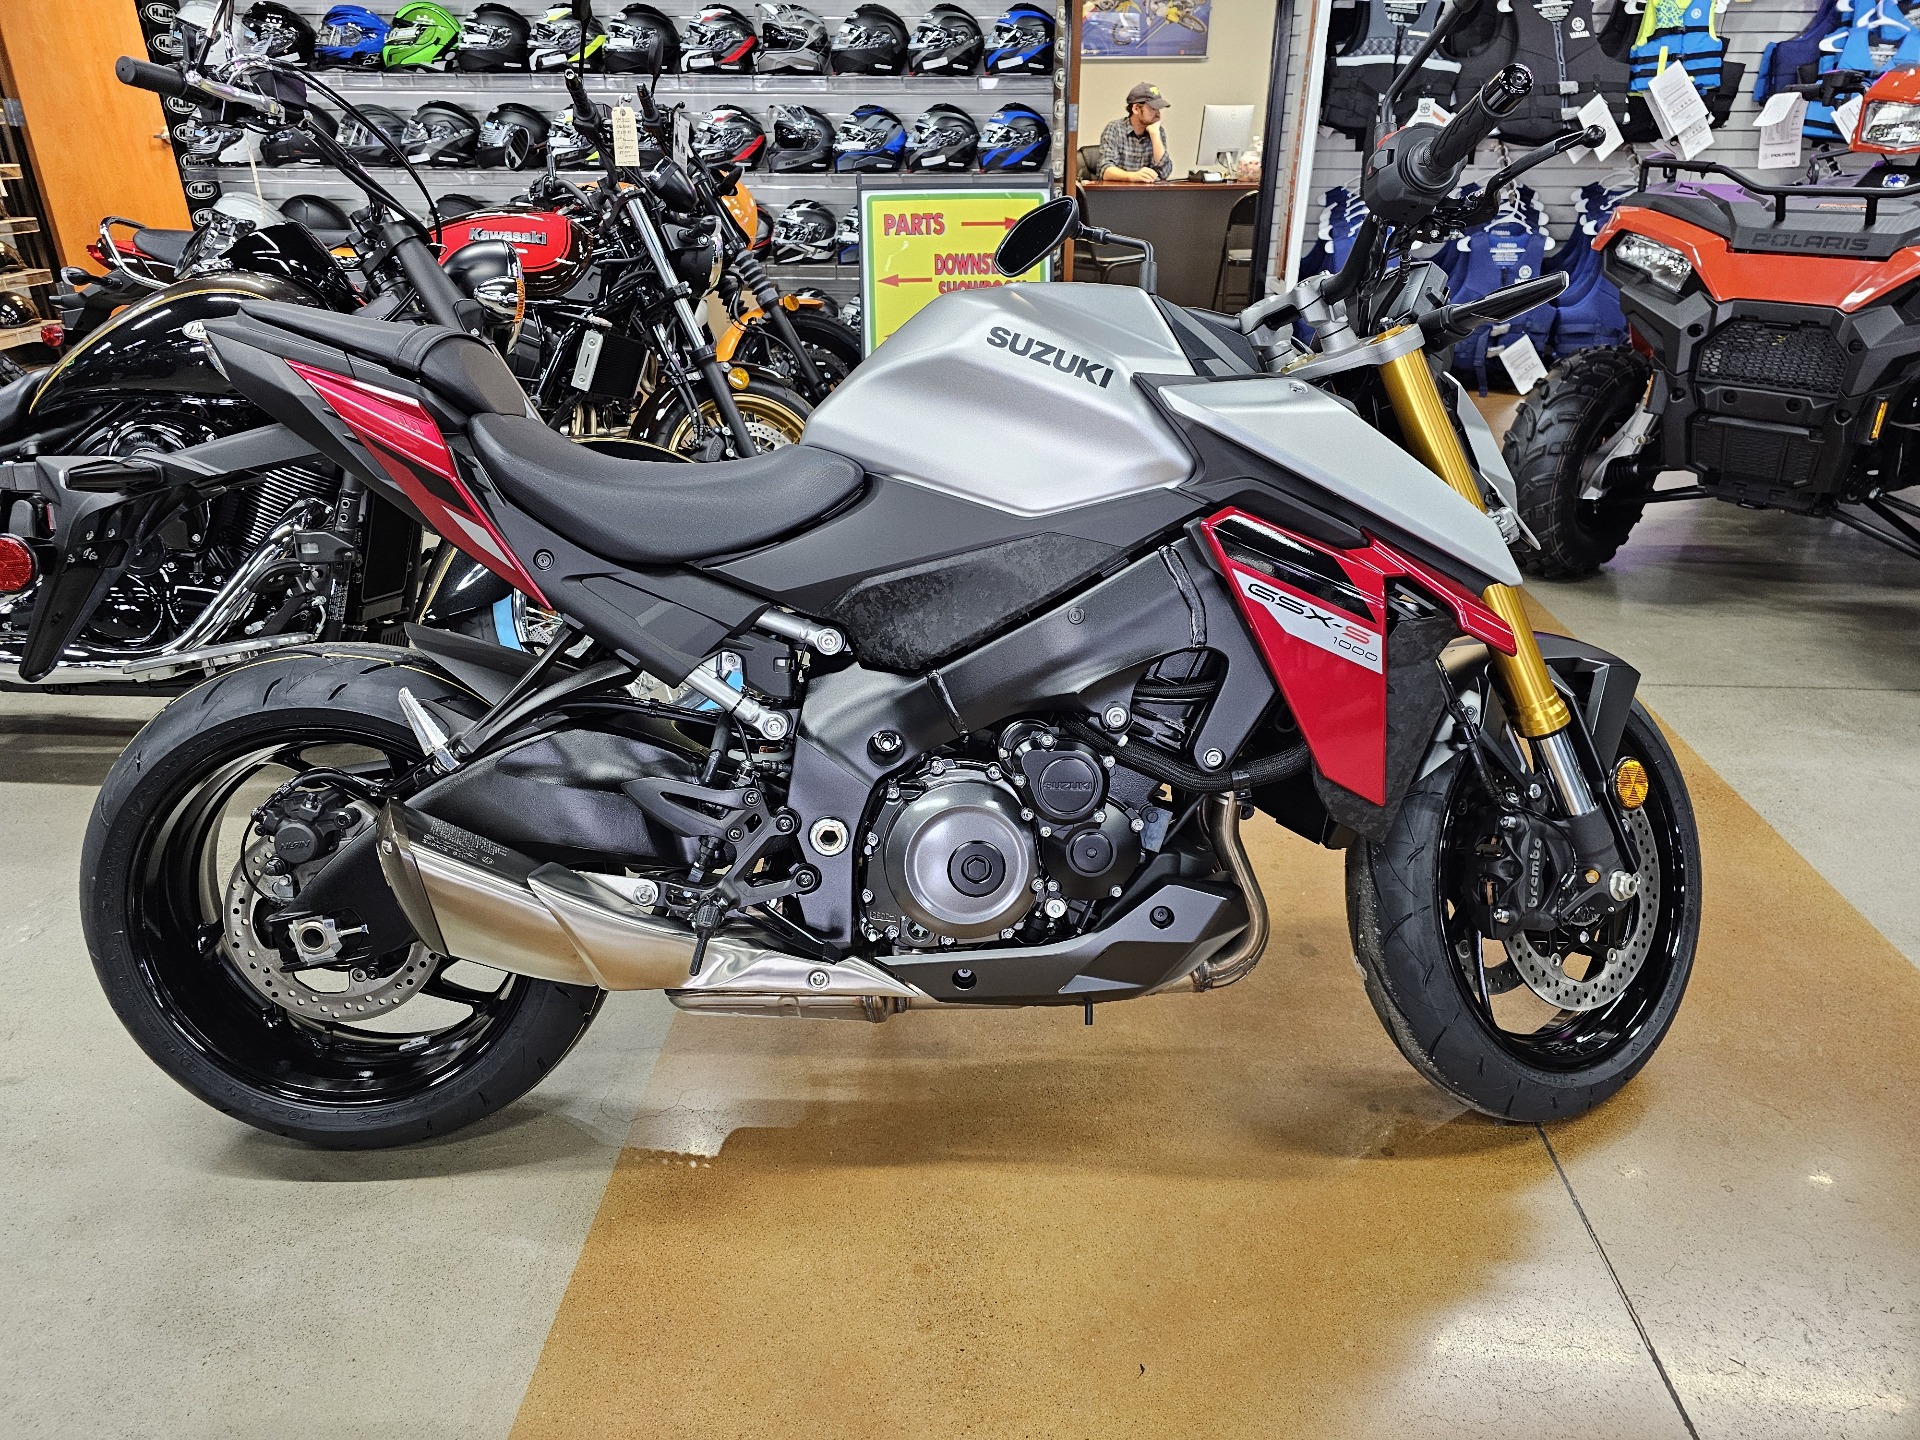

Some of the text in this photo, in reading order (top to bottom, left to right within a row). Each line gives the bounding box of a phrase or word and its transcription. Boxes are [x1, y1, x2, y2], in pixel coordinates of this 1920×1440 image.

[151, 8, 174, 19] HJC
[191, 185, 212, 195] HJC
[884, 213, 946, 236] PARTS
[469, 228, 547, 245] Kawasaki
[1751, 232, 1871, 251] POLARIS
[986, 326, 1115, 389] SUZUKI
[1248, 583, 1373, 645] GSX-S
[1333, 636, 1379, 662] 1000
[1043, 781, 1093, 791] SUZUKI
[1527, 837, 1542, 908] brembo
